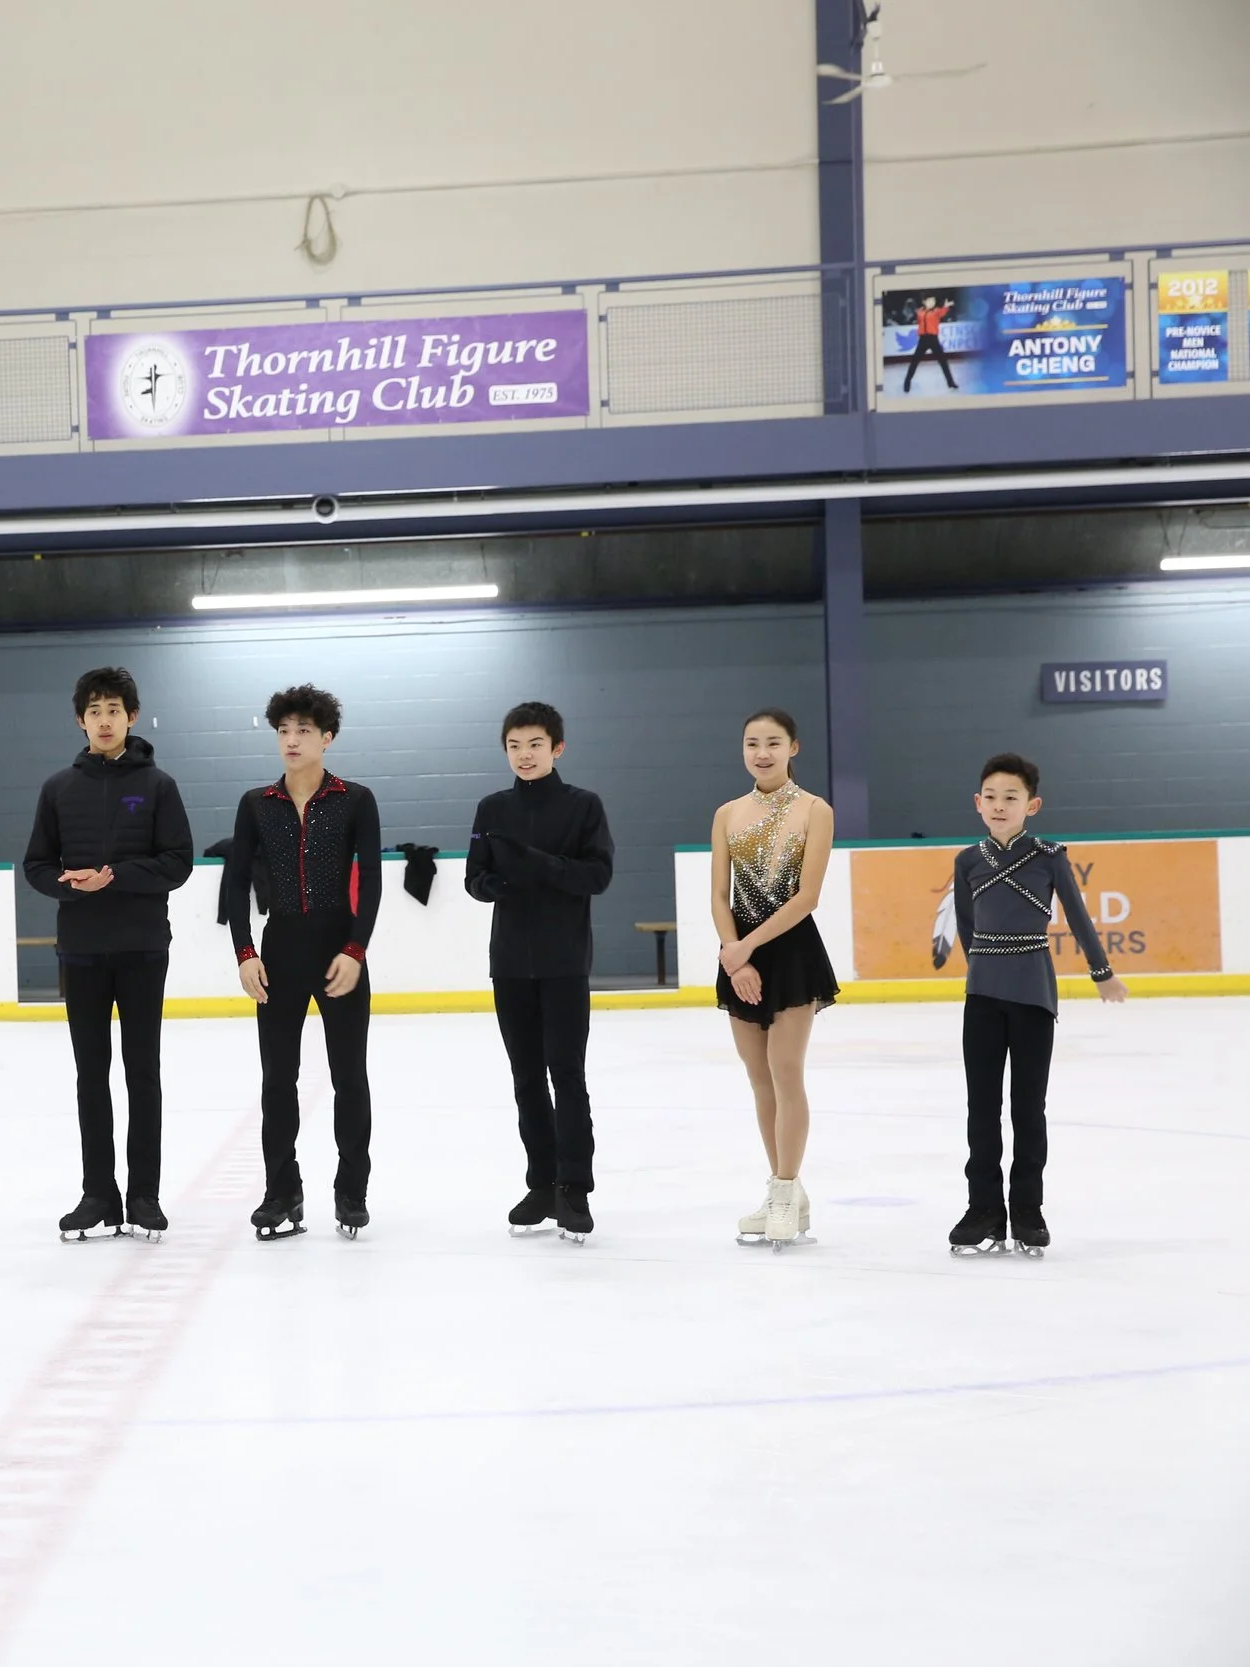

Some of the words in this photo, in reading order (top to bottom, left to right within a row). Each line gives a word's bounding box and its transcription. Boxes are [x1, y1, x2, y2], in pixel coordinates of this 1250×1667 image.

[1004, 290, 1063, 303] Thornhill
[1066, 287, 1107, 301] Figure
[1168, 279, 1218, 297] 2012
[1003, 302, 1049, 315] Skating
[1052, 299, 1083, 312] Club
[1166, 325, 1221, 338] PRE-NOVICE
[1008, 334, 1102, 357] ANTONY
[1182, 337, 1204, 348] MEN
[204, 334, 407, 379] Thornhill
[417, 333, 557, 377] Figure
[1170, 348, 1217, 360] NATIONAL
[1016, 354, 1096, 376] CHENG
[1168, 359, 1219, 372] CHAMPION
[203, 383, 361, 423] Skating
[372, 372, 475, 411] Club
[493, 392, 520, 401] EST.
[525, 387, 553, 400] 1975
[1054, 667, 1163, 693] VISITORS
